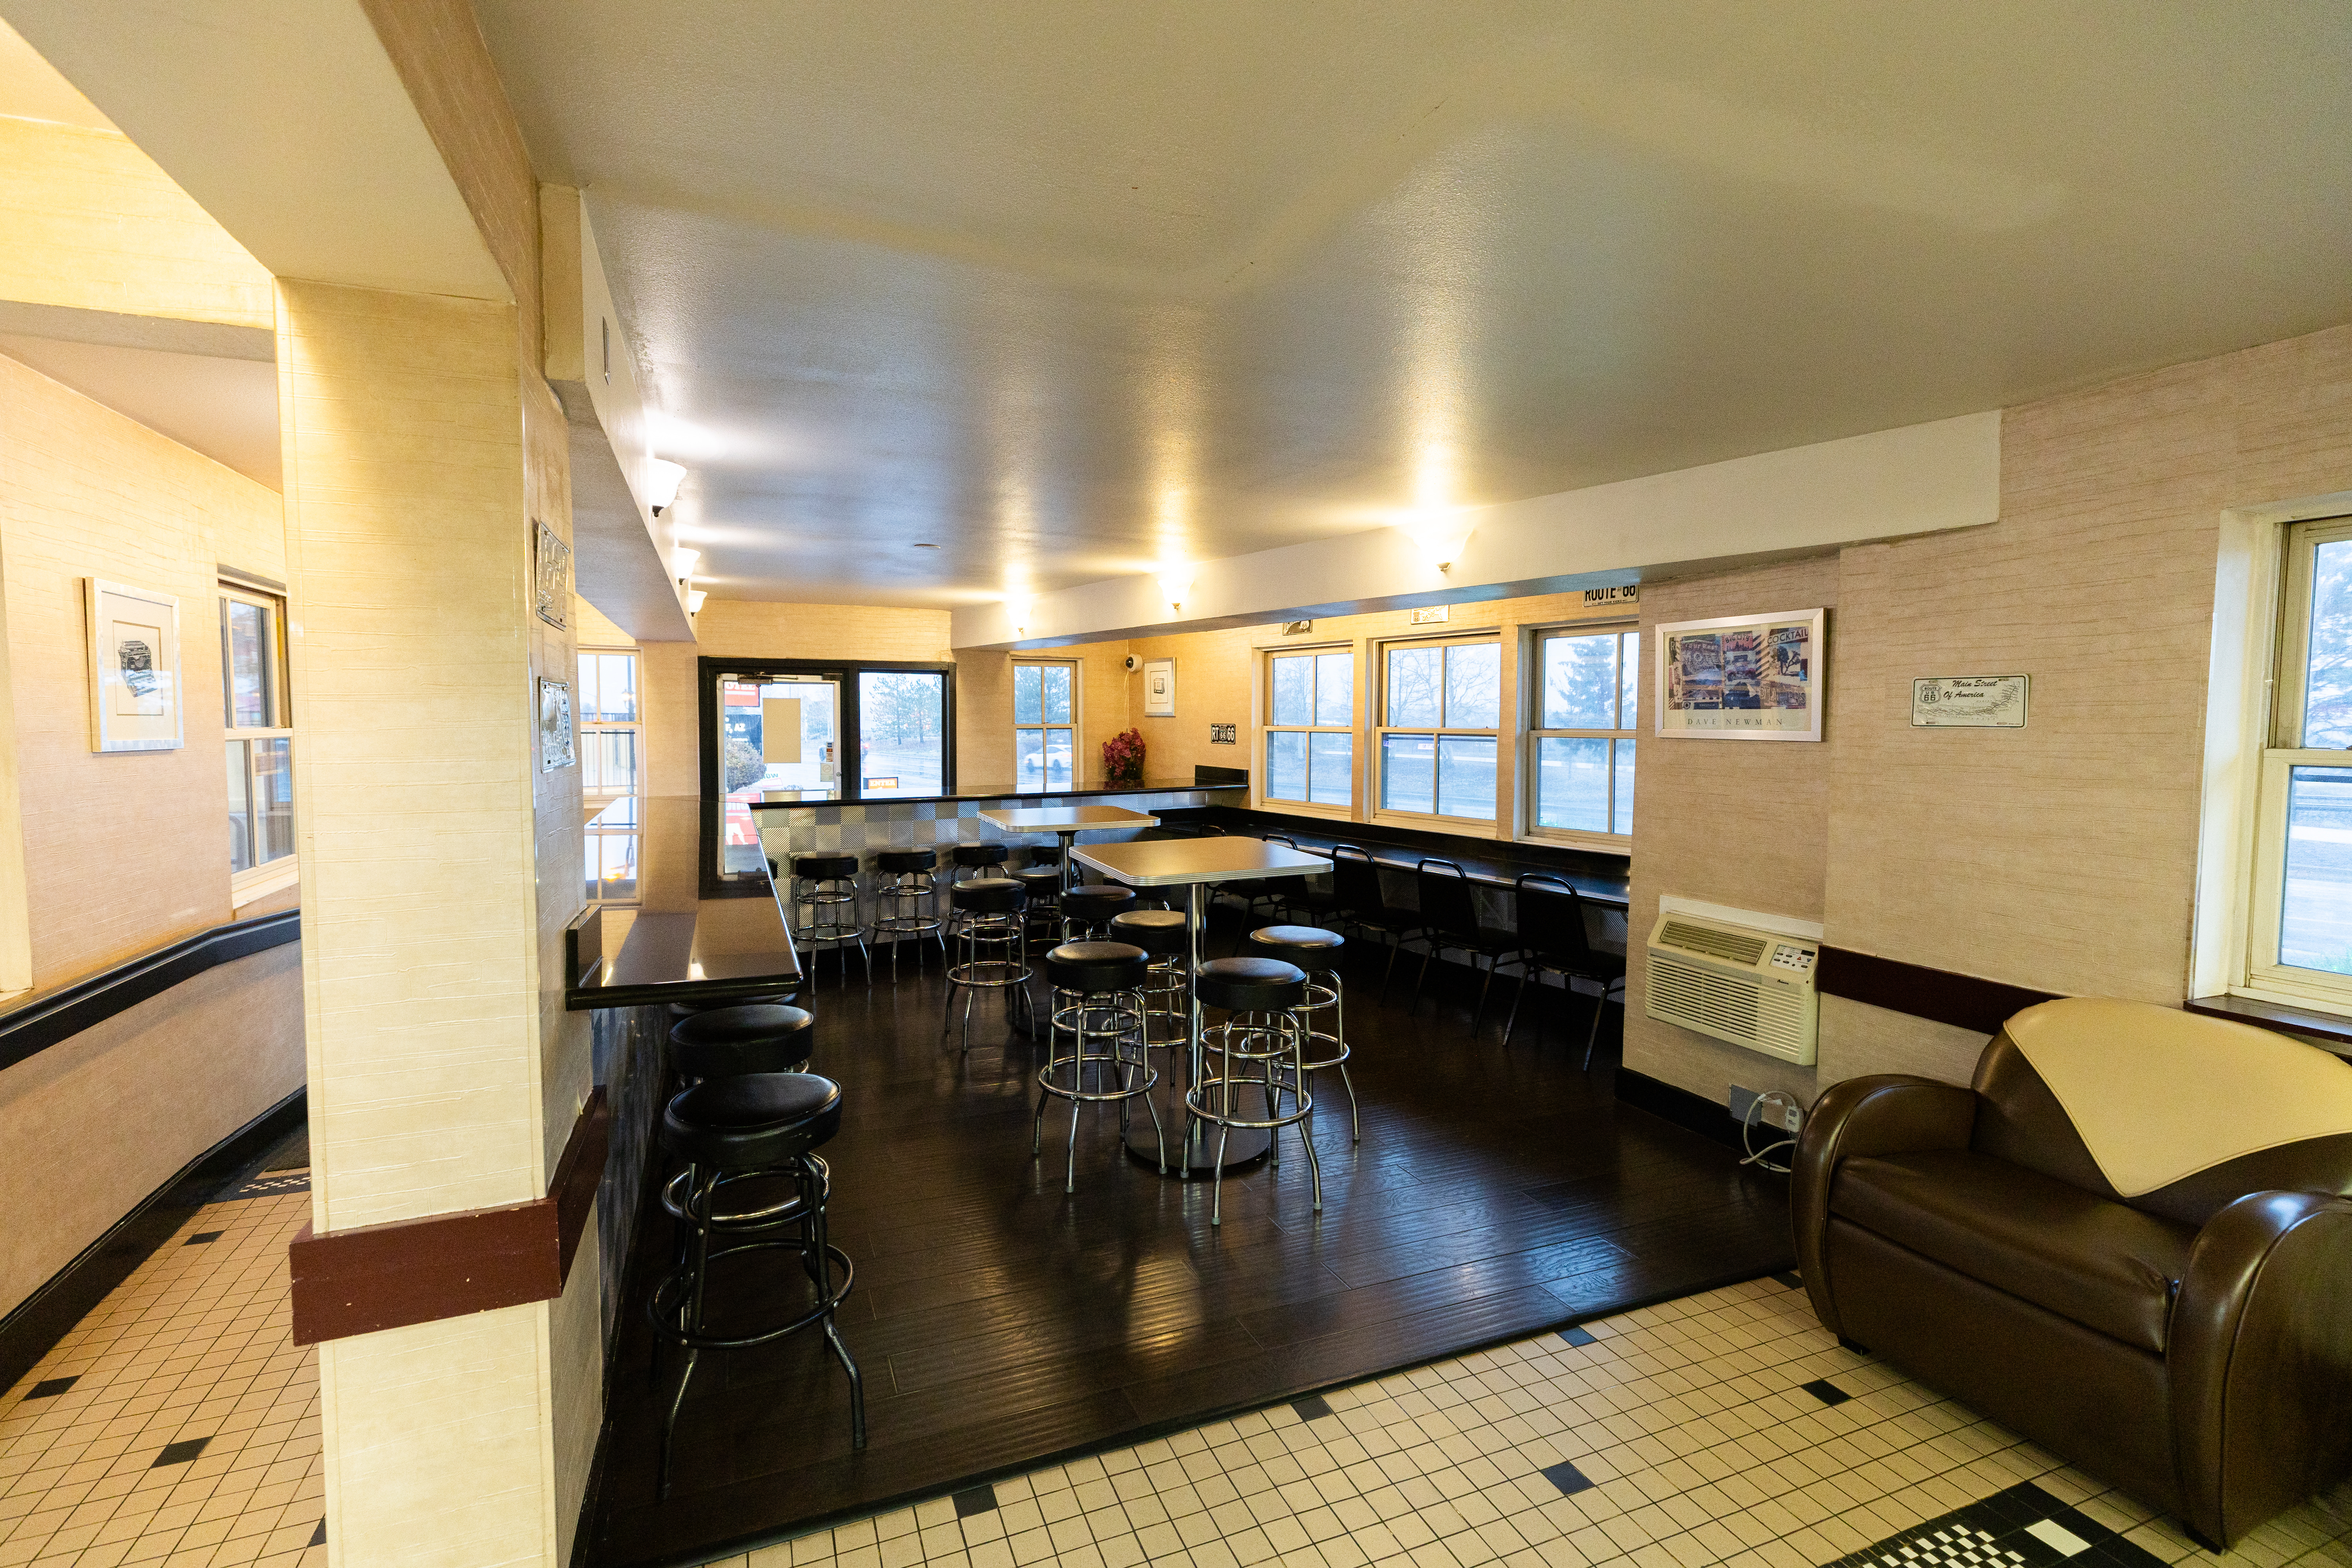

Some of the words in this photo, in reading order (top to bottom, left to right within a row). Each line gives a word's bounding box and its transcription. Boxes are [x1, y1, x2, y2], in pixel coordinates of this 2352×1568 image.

[1737, 633, 1750, 642] CITY
[1767, 628, 1808, 644] COCKTAIL
[1943, 691, 1953, 700] Of
[734, 723, 746, 731] AZ
[1212, 727, 1219, 740] RT
[1227, 727, 1234, 741] 66
